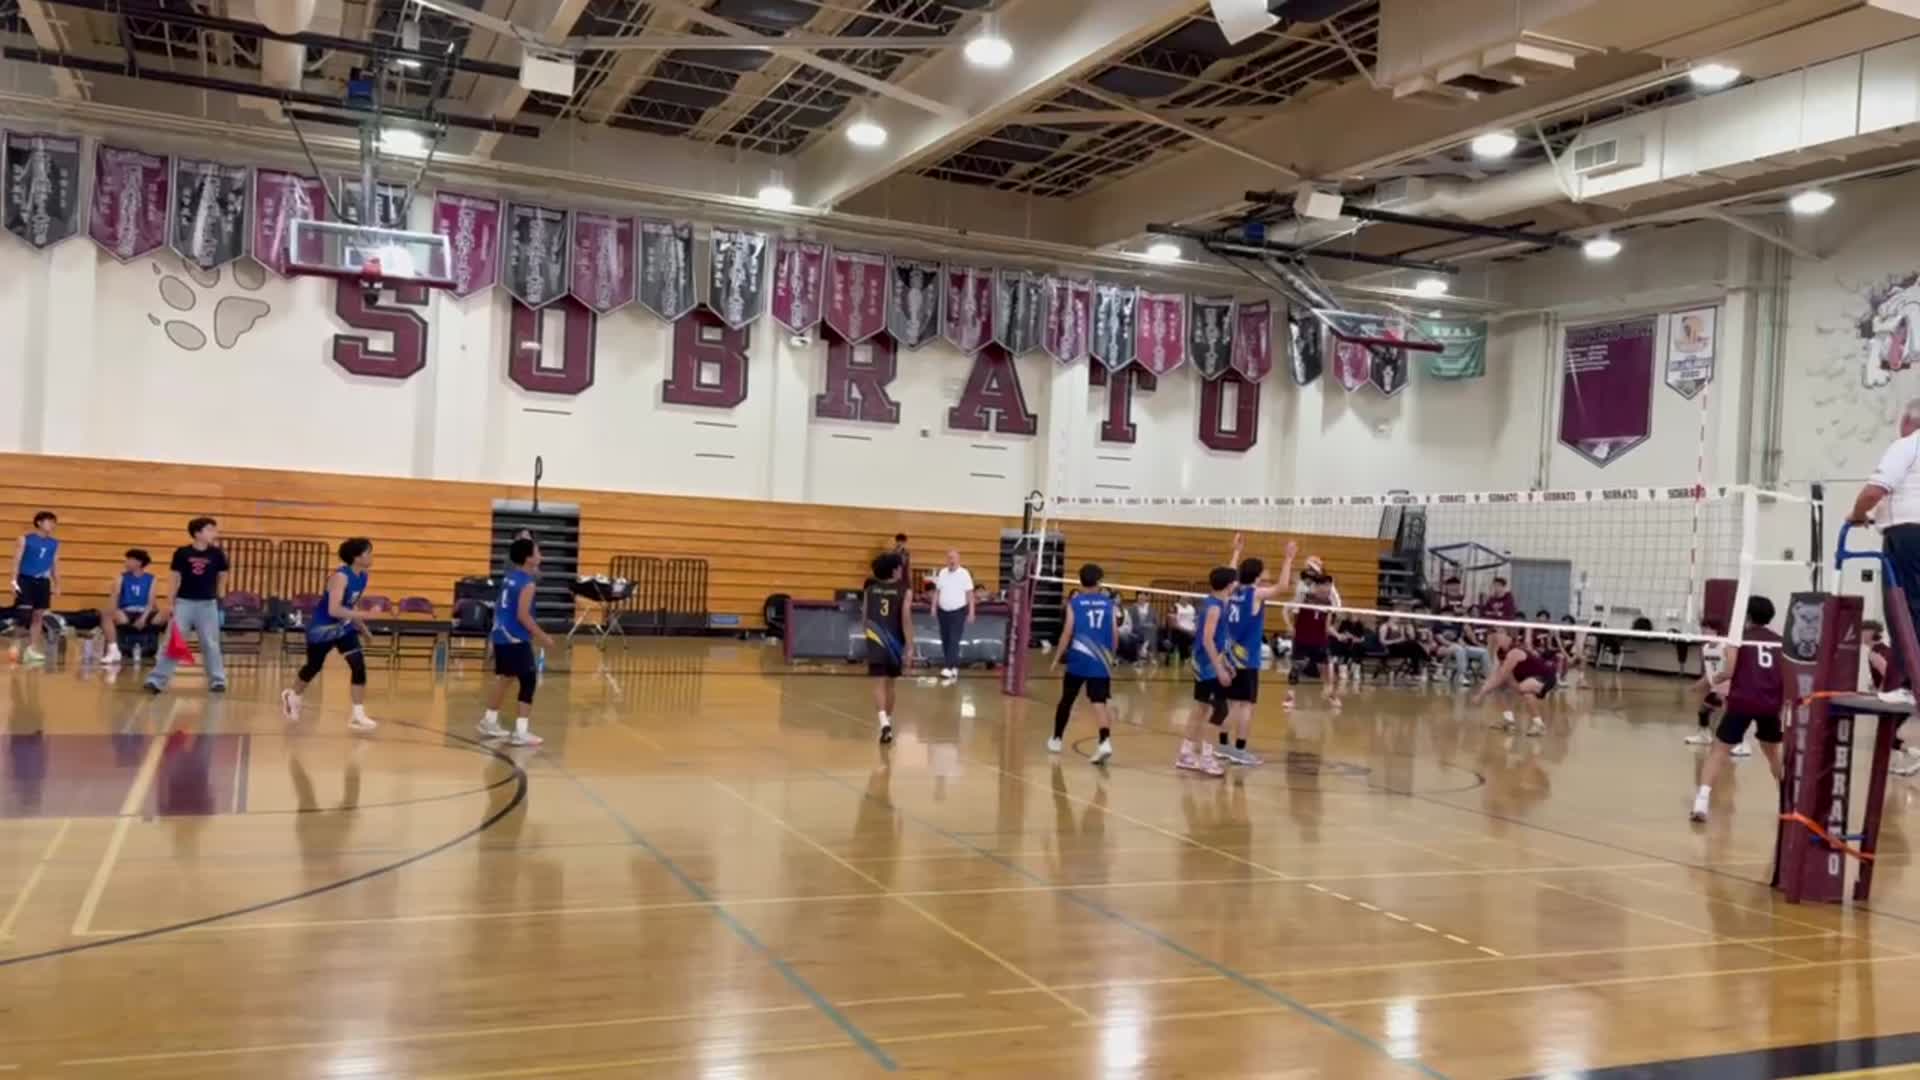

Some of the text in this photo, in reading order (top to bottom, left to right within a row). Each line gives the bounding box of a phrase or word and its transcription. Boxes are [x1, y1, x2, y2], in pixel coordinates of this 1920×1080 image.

[880, 598, 889, 617] 3
[1086, 609, 1105, 629] 17
[1758, 642, 1774, 668] 6
